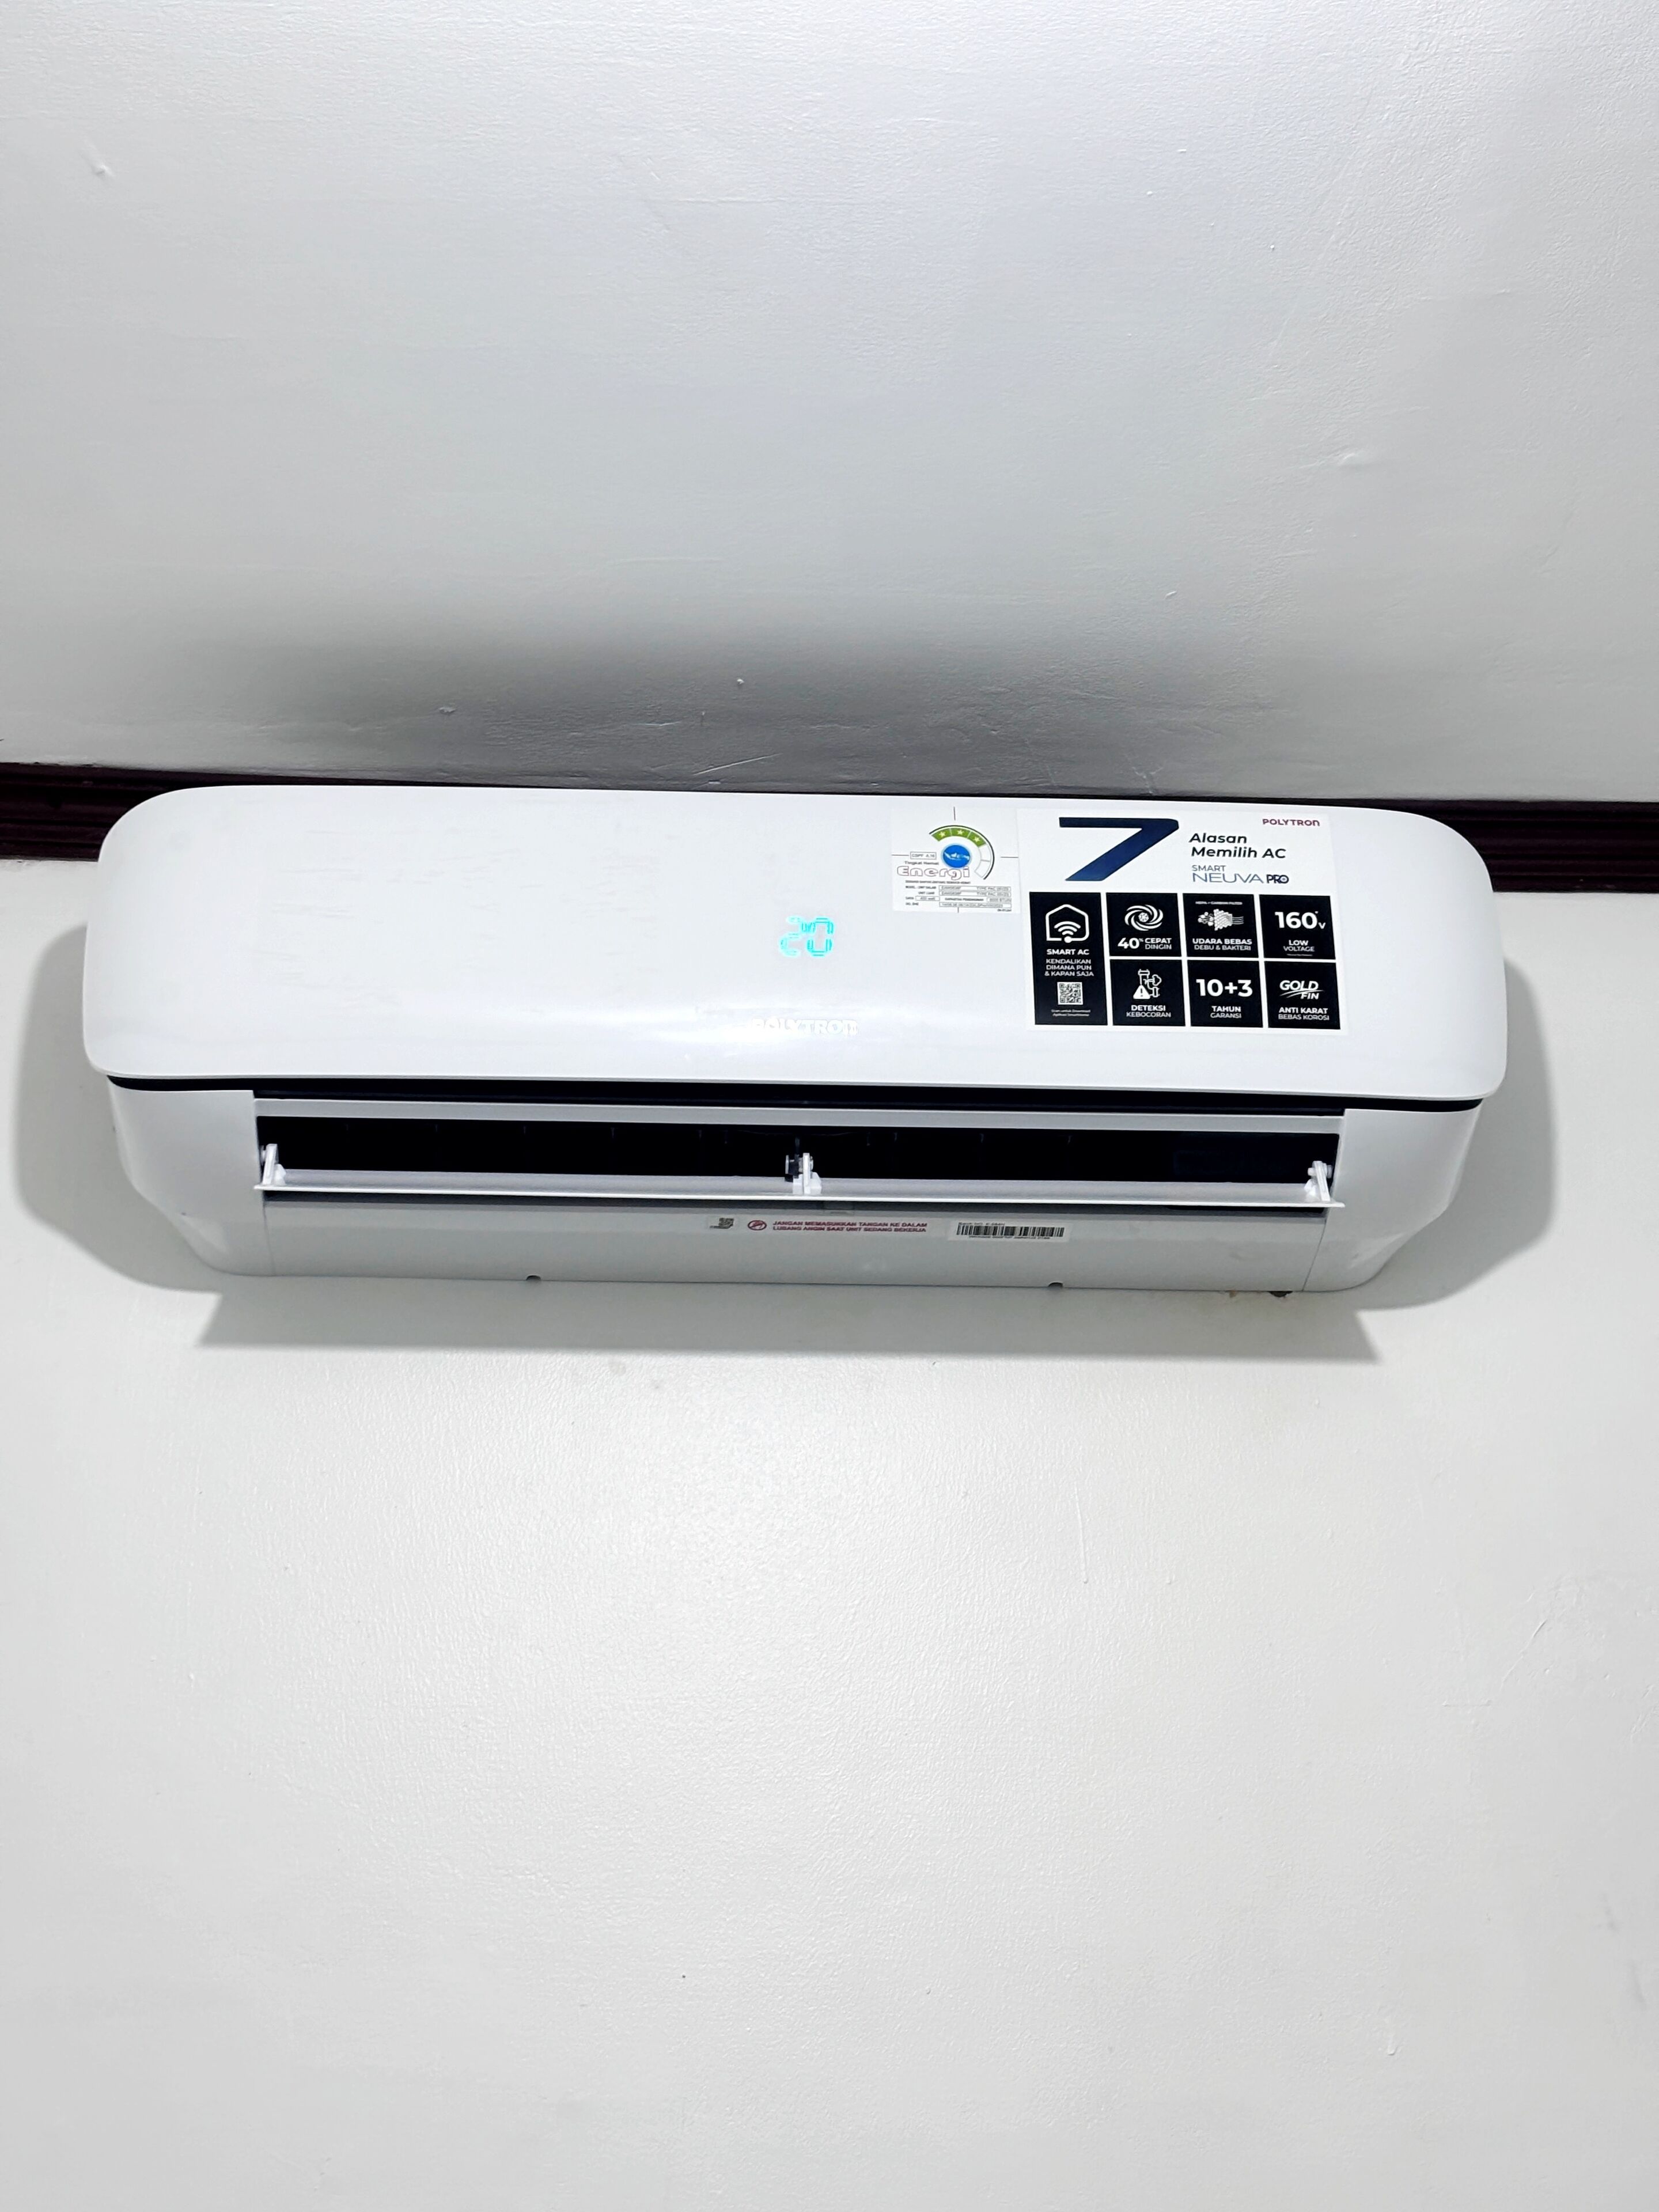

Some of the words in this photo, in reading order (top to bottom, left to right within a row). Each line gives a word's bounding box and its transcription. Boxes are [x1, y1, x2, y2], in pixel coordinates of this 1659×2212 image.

[1262, 818, 1320, 827] POLYTRON
[1189, 832, 1247, 844] Alasan
[1059, 817, 1179, 881] 7
[1191, 846, 1257, 858] Memilih
[1262, 848, 1286, 859] AC
[897, 866, 969, 880] Energi
[1192, 873, 1263, 884] NEUVA
[1266, 874, 1289, 884] PRO
[779, 916, 835, 957] 20
[1196, 979, 1252, 997] 10+3
[1279, 980, 1319, 990] GOLD
